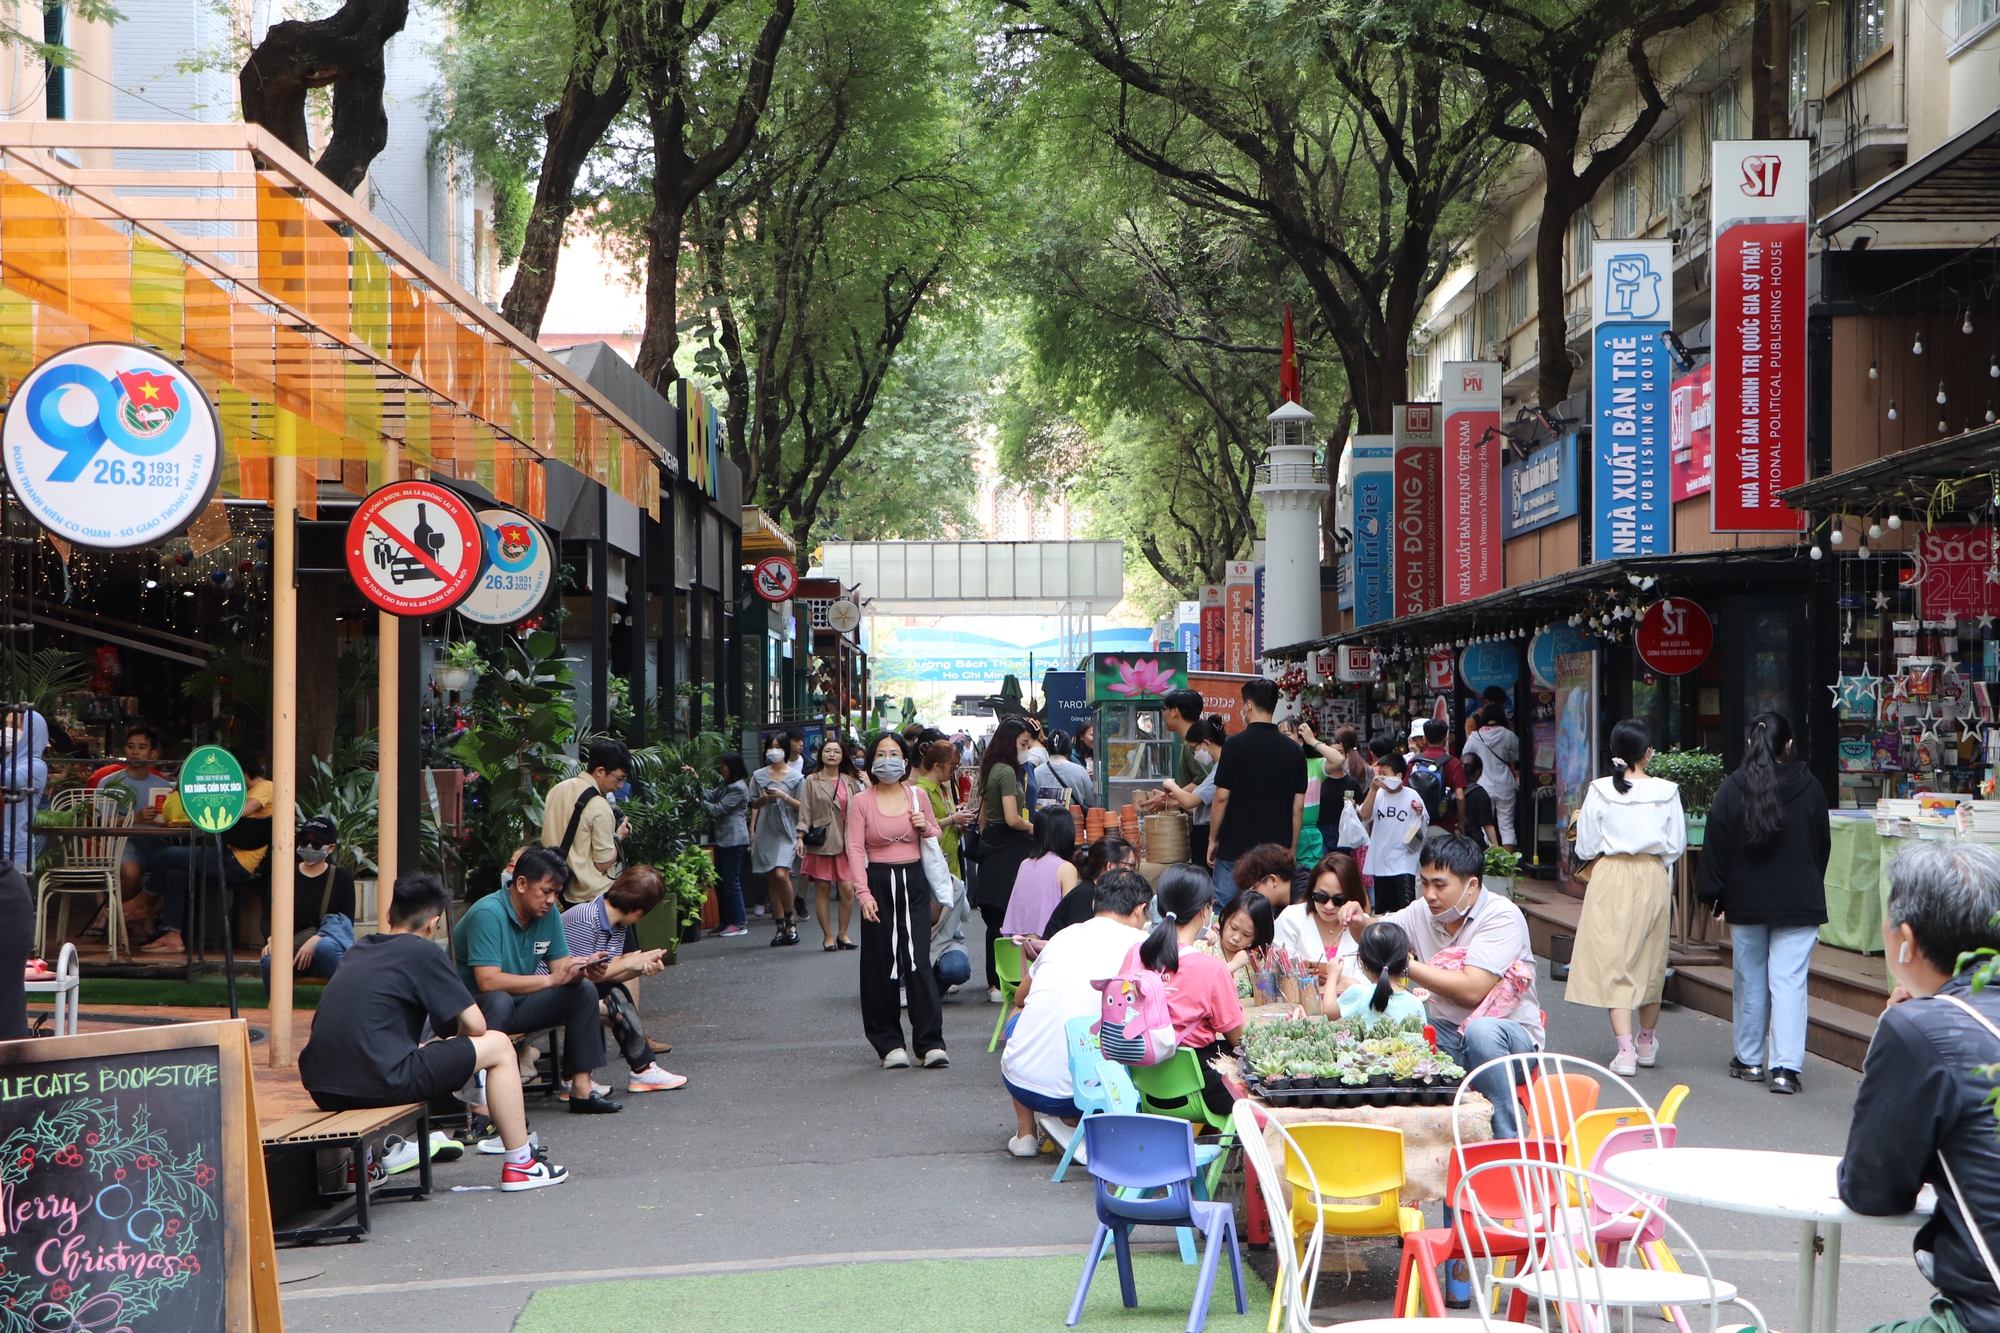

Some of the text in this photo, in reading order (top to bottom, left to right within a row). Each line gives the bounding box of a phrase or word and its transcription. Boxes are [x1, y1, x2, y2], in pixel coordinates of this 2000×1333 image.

[1739, 155, 1782, 197] ST
[1463, 377, 1482, 392] PN
[1736, 240, 1764, 508] NHÀ XUẤT BẢN CHÍNH TRỊ QUỐC GIA SỰ THẬT
[1770, 241, 1782, 508] NATIONAL POLITICAL PUBLISHING HOUSE
[686, 379, 719, 502] BOOK
[1604, 337, 1636, 554] NHÀ XUẤT BẢN TRẺ
[1641, 334, 1654, 555] TRE PUBLISHING HOUSE
[13, 446, 25, 476] ĐOÀN
[94, 459, 146, 486] 26.3
[149, 462, 180, 475] 1931
[191, 454, 204, 470] TẢI
[20, 475, 43, 508] THANH
[148, 475, 180, 488] 2021
[184, 471, 199, 492] VẬN
[1479, 462, 1489, 506] Publishing
[42, 504, 64, 525] NIÊN
[160, 492, 189, 523] THÔNG
[369, 500, 384, 513] UỐNG
[421, 490, 443, 503] KHÔNG
[442, 499, 452, 509] LÁI
[1455, 420, 1472, 596] NHÀ XUẤT BẢN PHỤ NỮ VIỆT NAM
[65, 520, 80, 532] CƠ
[82, 526, 111, 539] QUAN
[120, 525, 134, 538] SỞ
[136, 517, 161, 534] GIAO
[1399, 453, 1423, 613] SÁCH ĐÔNG A
[1479, 508, 1487, 545] Women's
[1925, 534, 2000, 563] Sác
[1479, 547, 1487, 582] Vietnam
[362, 576, 370, 585] AN
[368, 583, 383, 598] TOÀN
[383, 594, 395, 604] CHO
[396, 599, 408, 608] BẠN
[427, 595, 444, 605] TOÀN
[443, 586, 455, 598] CHO
[485, 575, 513, 590] 26.3
[480, 613, 495, 621] QUAN
[500, 612, 507, 620] SỞ
[508, 607, 521, 618] GIAO
[522, 594, 537, 610] THÔNG
[534, 580, 542, 593] VẬN
[1231, 591, 1241, 609] HÀ
[1364, 575, 1380, 619] SÁCH
[1926, 607, 1963, 615] READNG
[1231, 611, 1240, 639] THÁI
[1663, 608, 1687, 634] ST
[955, 659, 988, 669] Sách
[1034, 658, 1059, 669] Phố
[984, 671, 1008, 680] Min
[1058, 701, 1087, 709] TAROT
[1377, 807, 1408, 822] ABC
[0, 1064, 218, 1101] LECATS BOOKSTORE
[35, 1235, 184, 1282] Christmas
